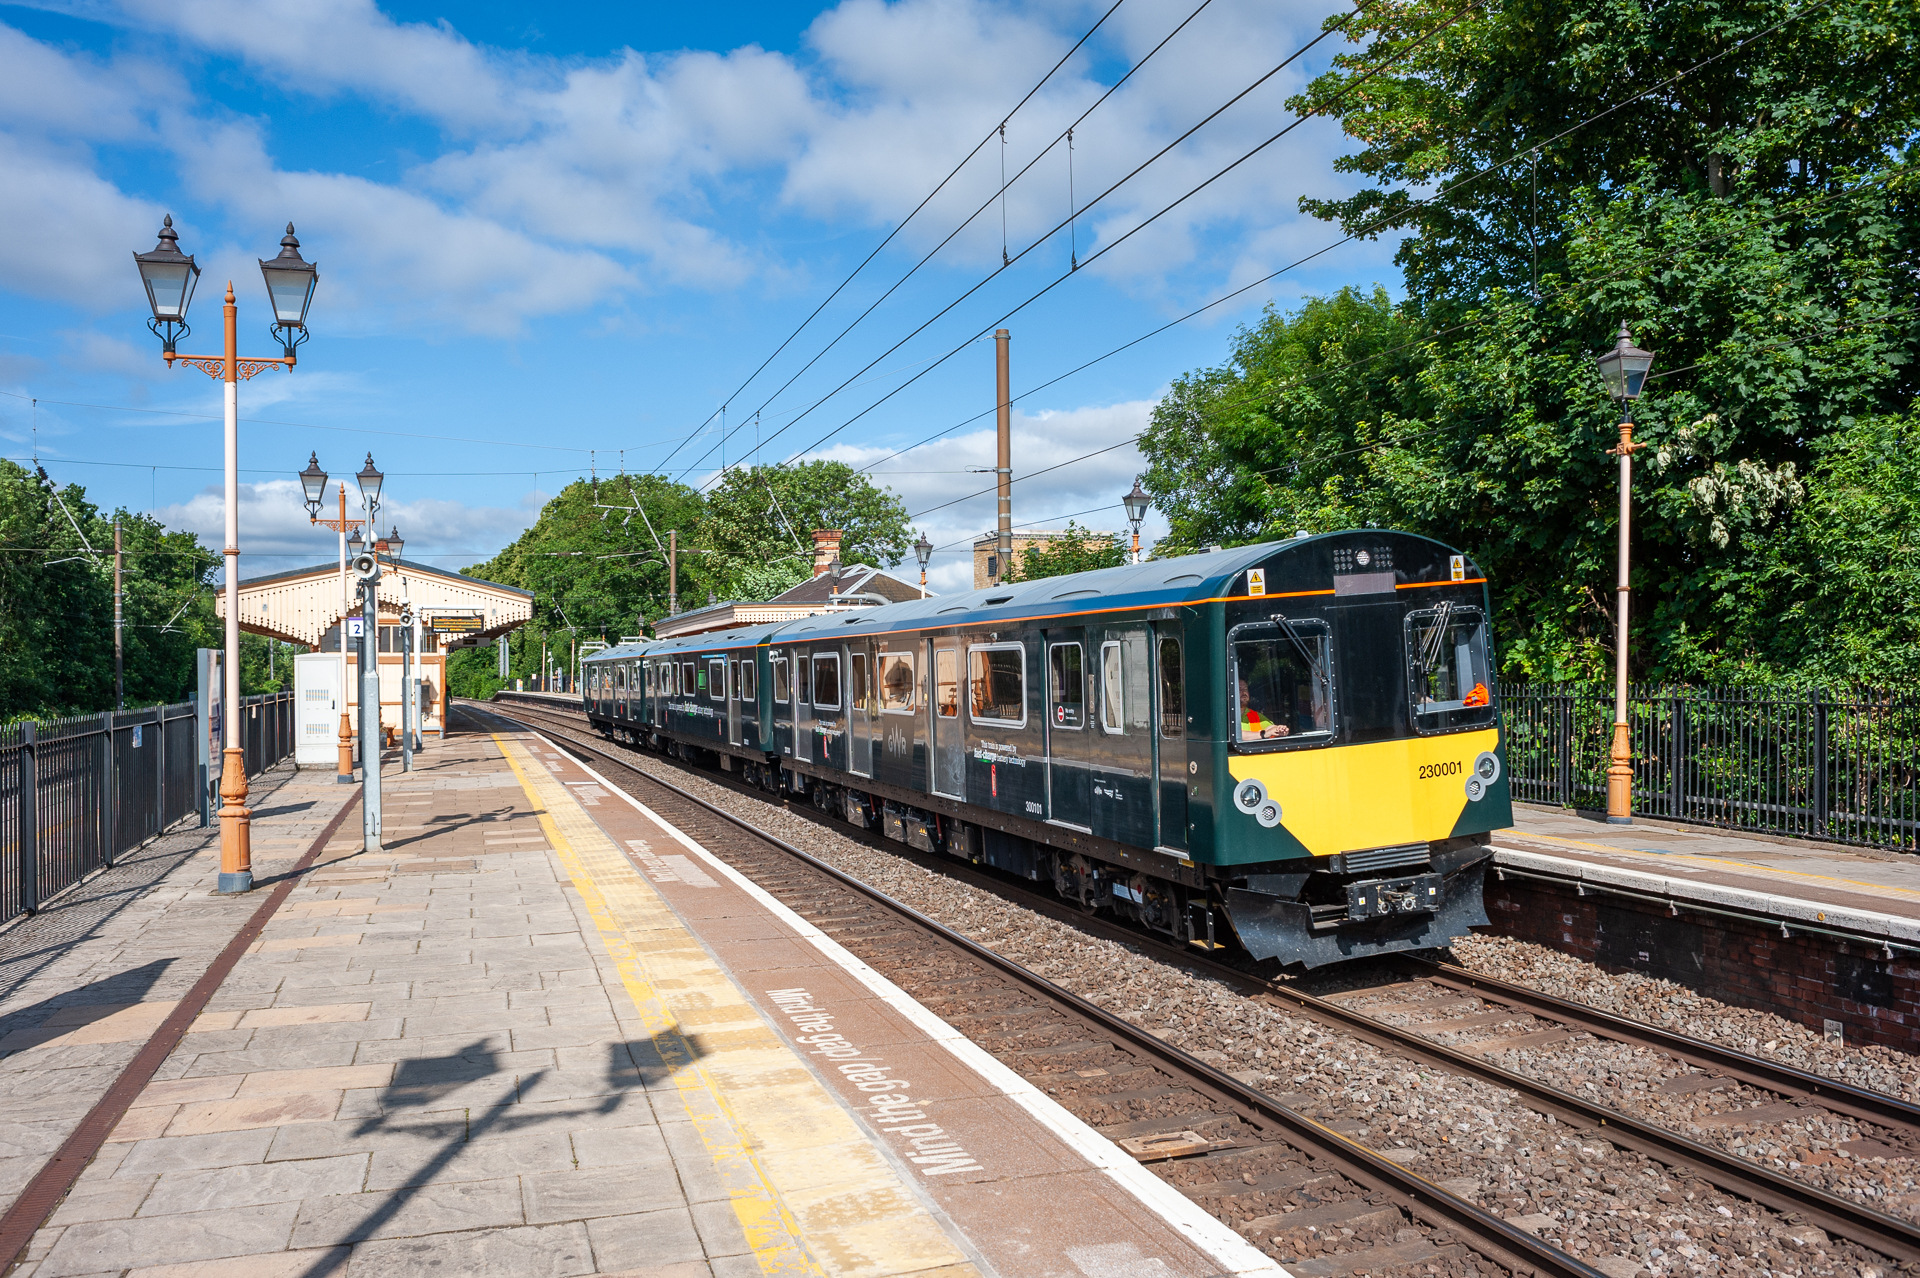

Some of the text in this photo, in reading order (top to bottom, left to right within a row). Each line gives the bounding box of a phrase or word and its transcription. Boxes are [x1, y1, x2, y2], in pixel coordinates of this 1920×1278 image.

[353, 623, 362, 635] 2
[887, 722, 907, 759] GWR
[973, 748, 996, 763] fast-charge
[1418, 760, 1462, 780] 230001
[1025, 801, 1043, 815] 300101
[765, 987, 862, 1058] Mind the gap
[837, 1063, 985, 1176] Mind the gap
